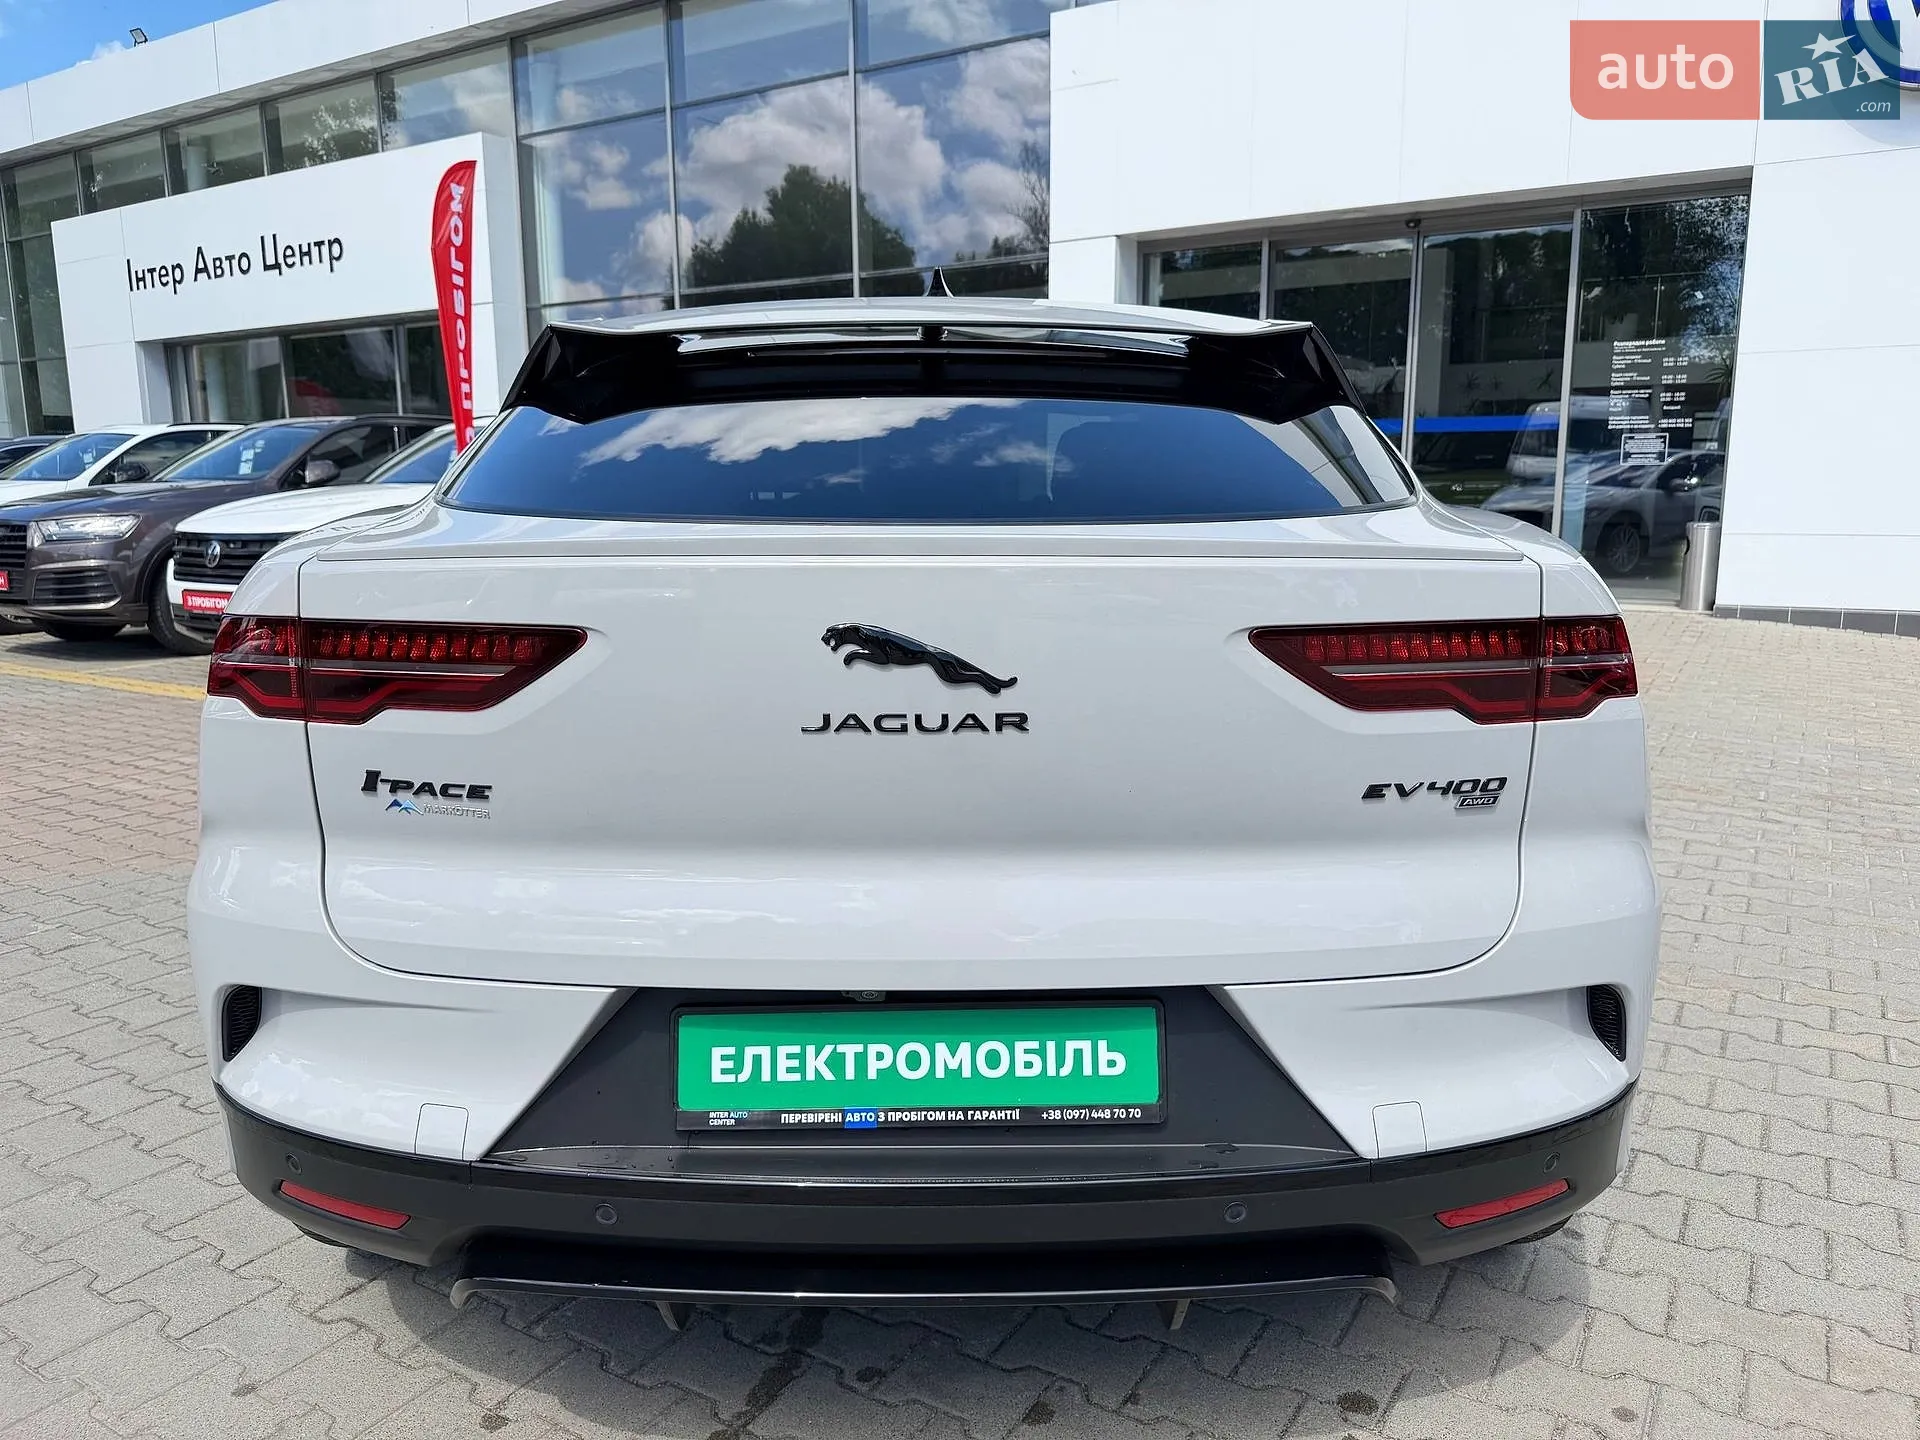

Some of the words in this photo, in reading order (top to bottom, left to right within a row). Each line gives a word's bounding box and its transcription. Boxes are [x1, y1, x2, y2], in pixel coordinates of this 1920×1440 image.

[126, 258, 185, 295] Інтер
[193, 246, 251, 282] Авто
[260, 233, 344, 276] Центр
[450, 183, 473, 410] ПРОБІГОМ
[800, 712, 1030, 734] JAGUAR
[1463, 796, 1493, 806] AWD
[710, 1039, 1127, 1083] ЕЛЕКТРОМОБІЛЬ
[781, 1113, 842, 1124] ПЕРЕВІРЕНІ
[846, 1112, 875, 1122] АВТО
[877, 1112, 885, 1122] З
[888, 1110, 946, 1122] ПРОБІГОМ
[948, 1110, 964, 1121] НА
[967, 1109, 1020, 1121] ГАРАНТІЇ
[1041, 1109, 1061, 1120] +38
[1063, 1109, 1089, 1120] (097)
[1091, 1109, 1111, 1119] 448
[1113, 1109, 1126, 1119] 70
[1128, 1108, 1141, 1119] 70
